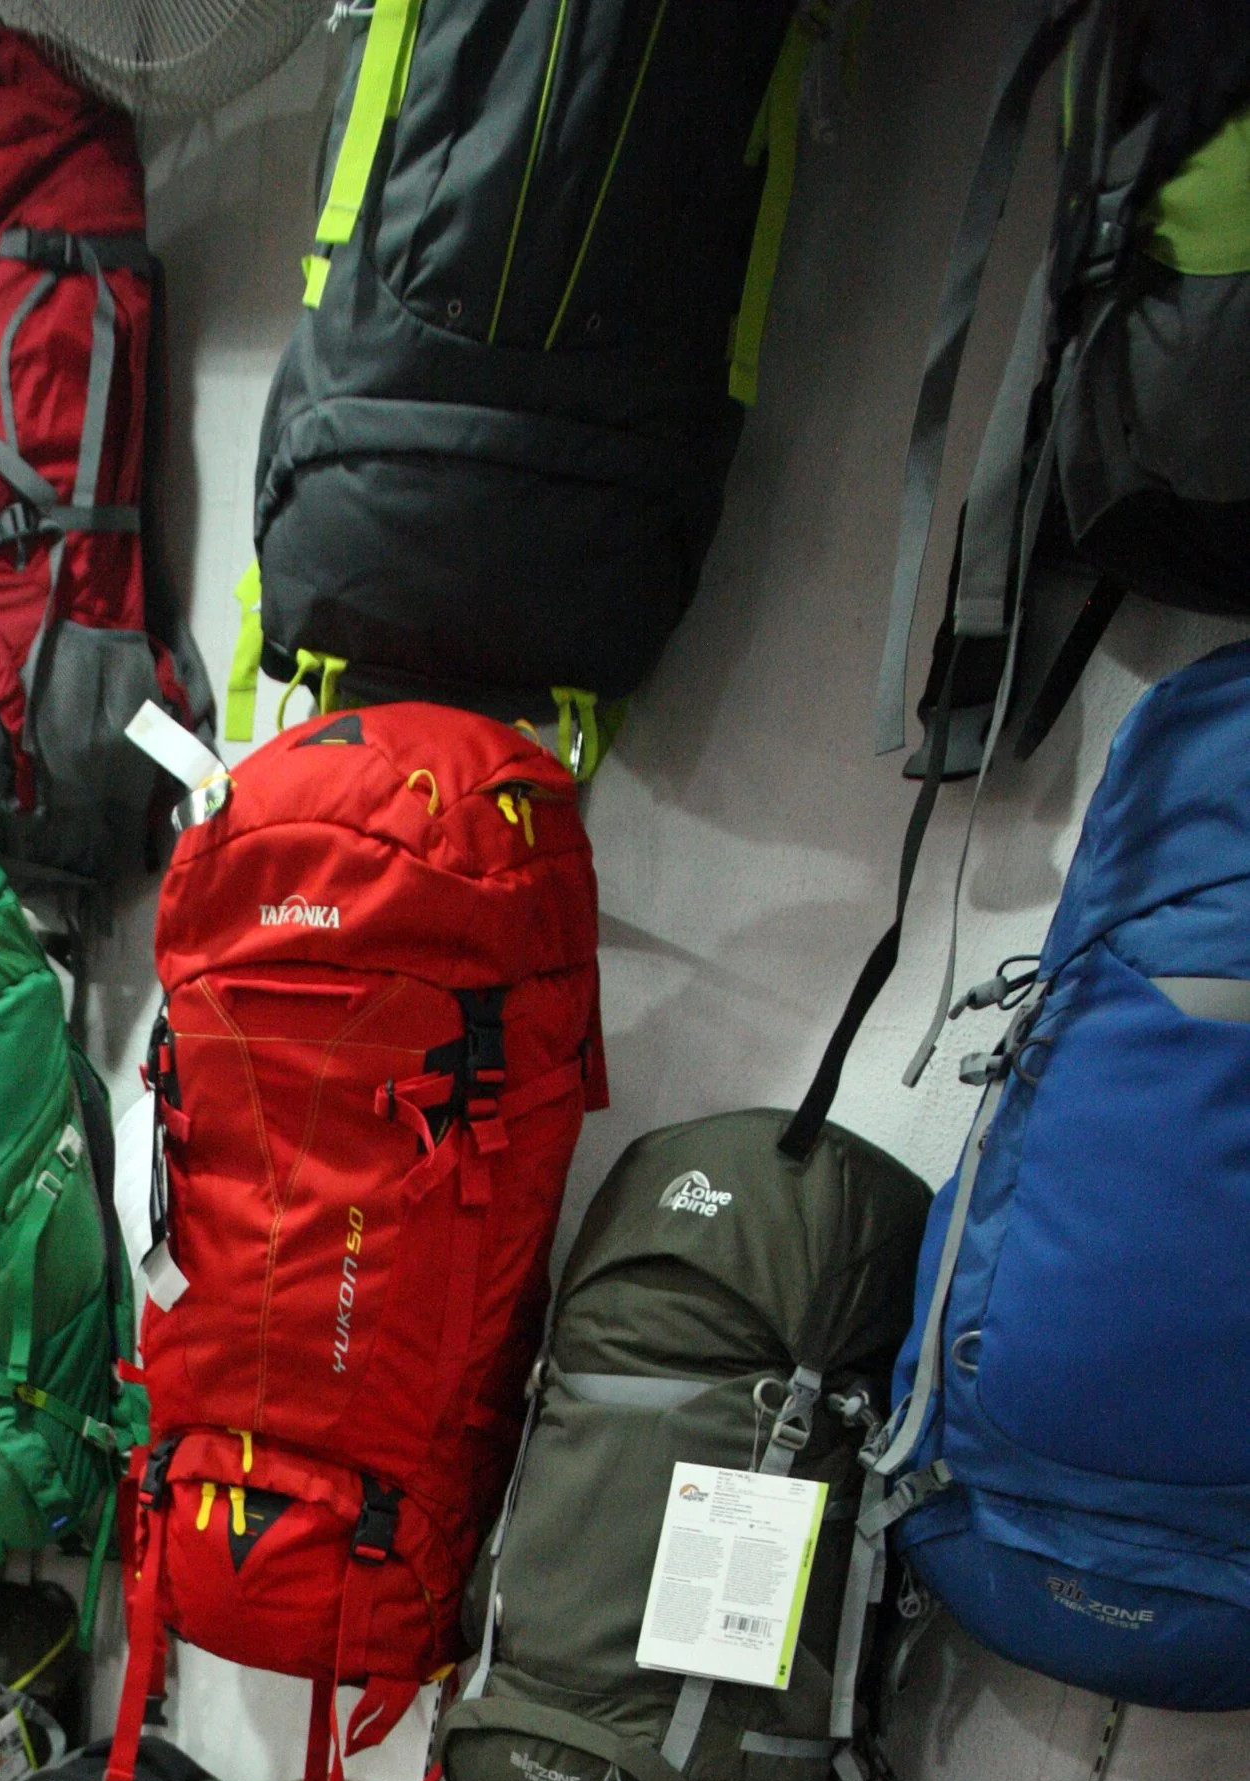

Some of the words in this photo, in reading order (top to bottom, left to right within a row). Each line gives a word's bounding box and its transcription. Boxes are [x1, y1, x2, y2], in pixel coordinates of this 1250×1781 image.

[681, 1181, 733, 1206] Lowe
[333, 1256, 358, 1373] YUKON
[346, 1206, 364, 1255] 50
